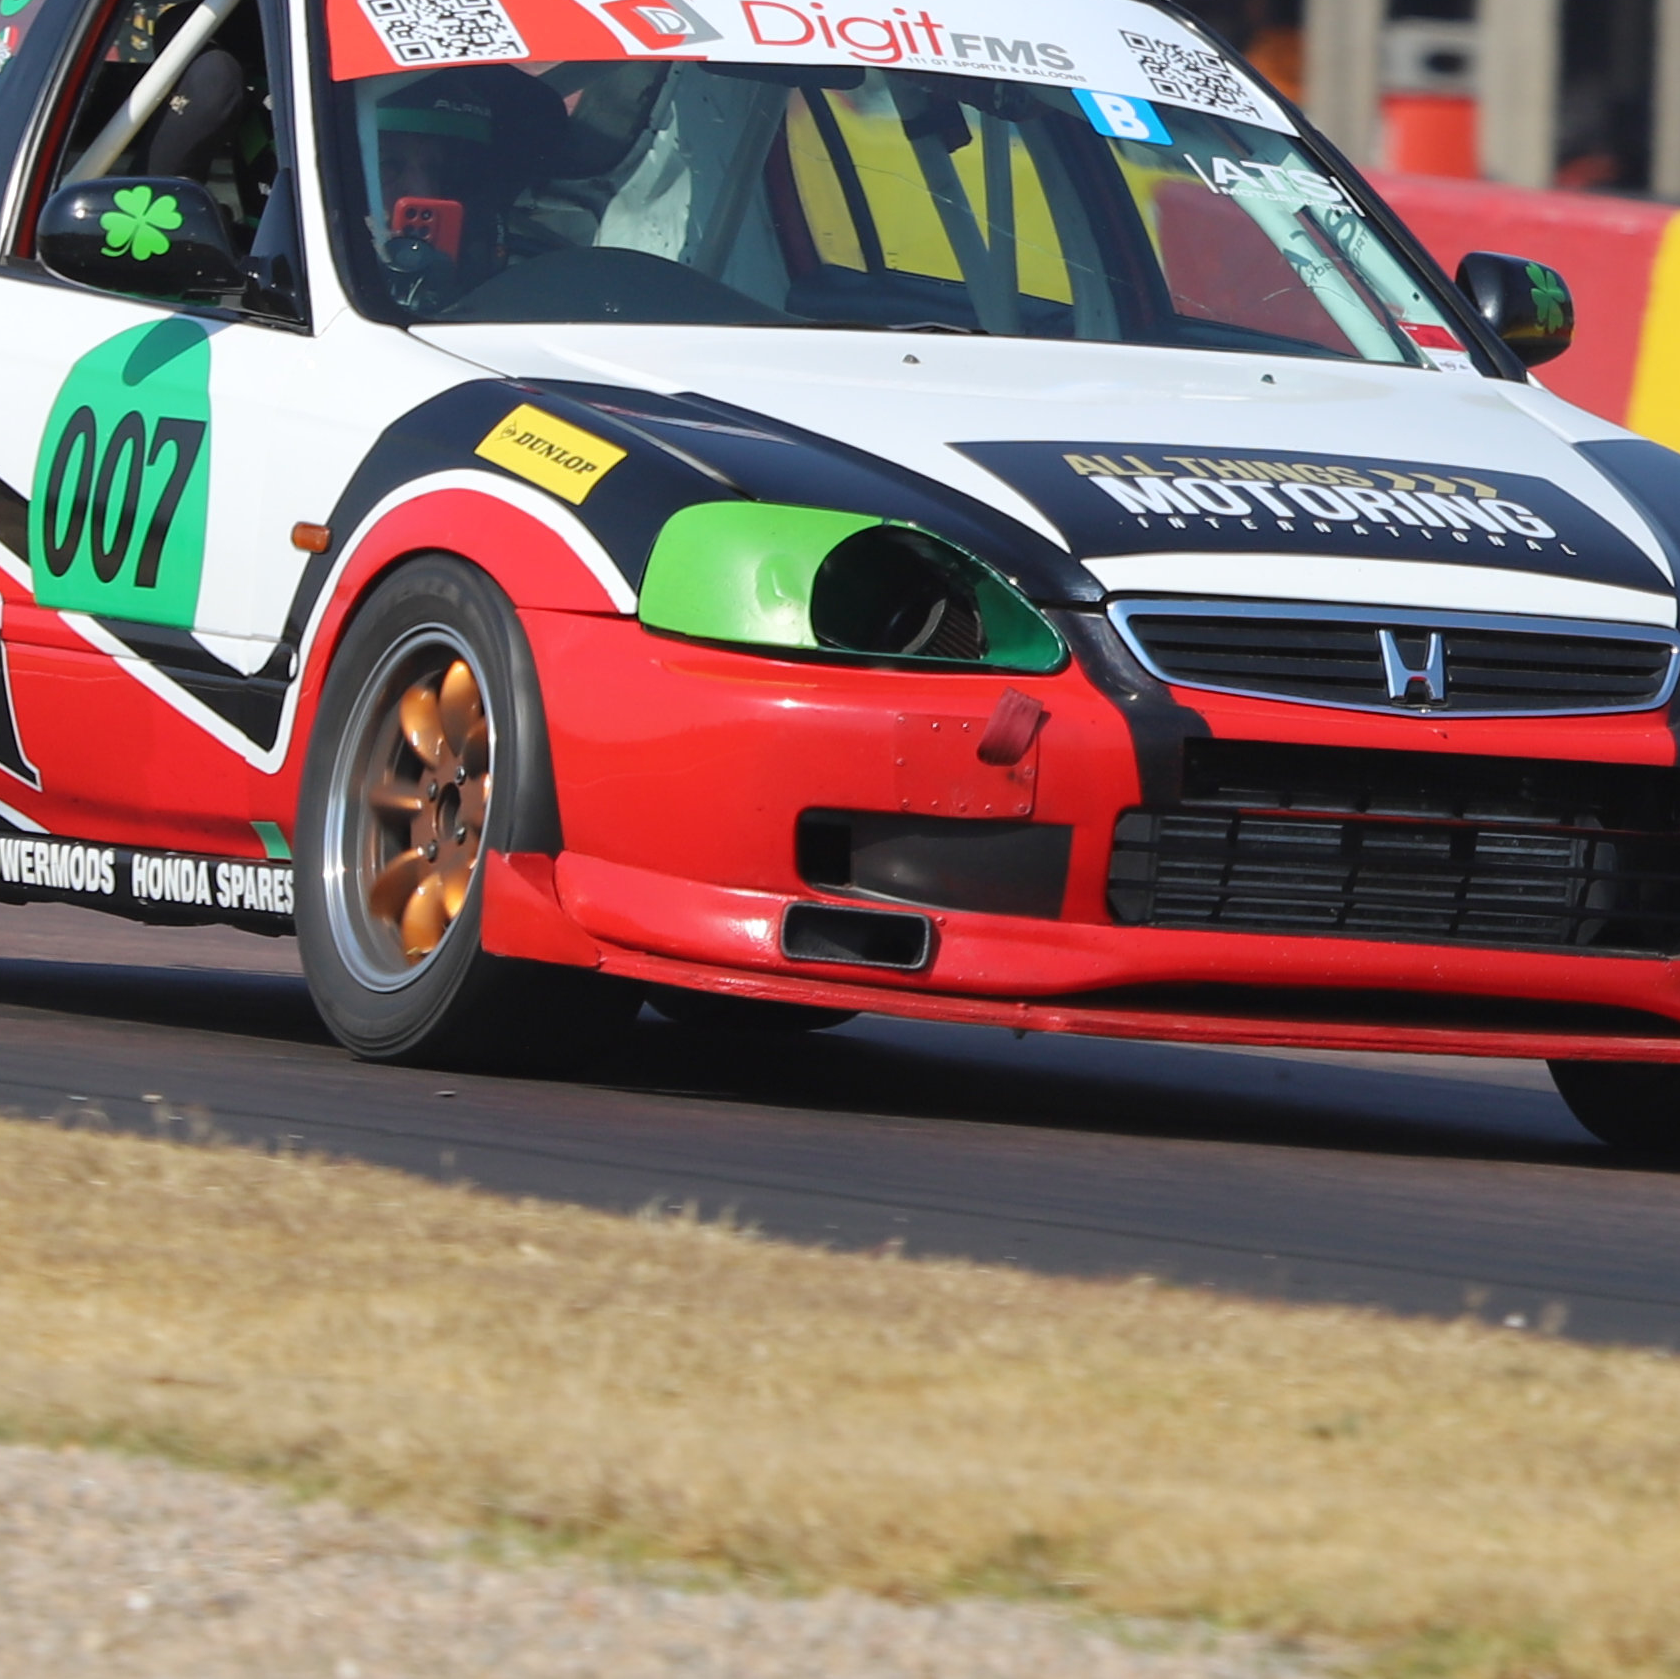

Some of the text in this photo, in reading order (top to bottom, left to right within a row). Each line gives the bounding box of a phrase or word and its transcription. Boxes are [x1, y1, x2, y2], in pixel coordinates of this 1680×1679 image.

[952, 60, 1008, 73] SPORTS
[1022, 68, 1087, 83] SALOONS
[1091, 91, 1150, 140] B
[1212, 156, 1344, 204] ATS
[1219, 186, 1354, 215] MOTORSPORT
[513, 431, 597, 475] DUNLOP
[1062, 453, 1374, 489] ALL THINGS
[43, 405, 207, 589] 007
[1088, 475, 1558, 540] MOTORING
[1137, 516, 1578, 558] INTERNATIONAL
[131, 853, 213, 907] HONDA
[216, 862, 294, 915] SPARES
